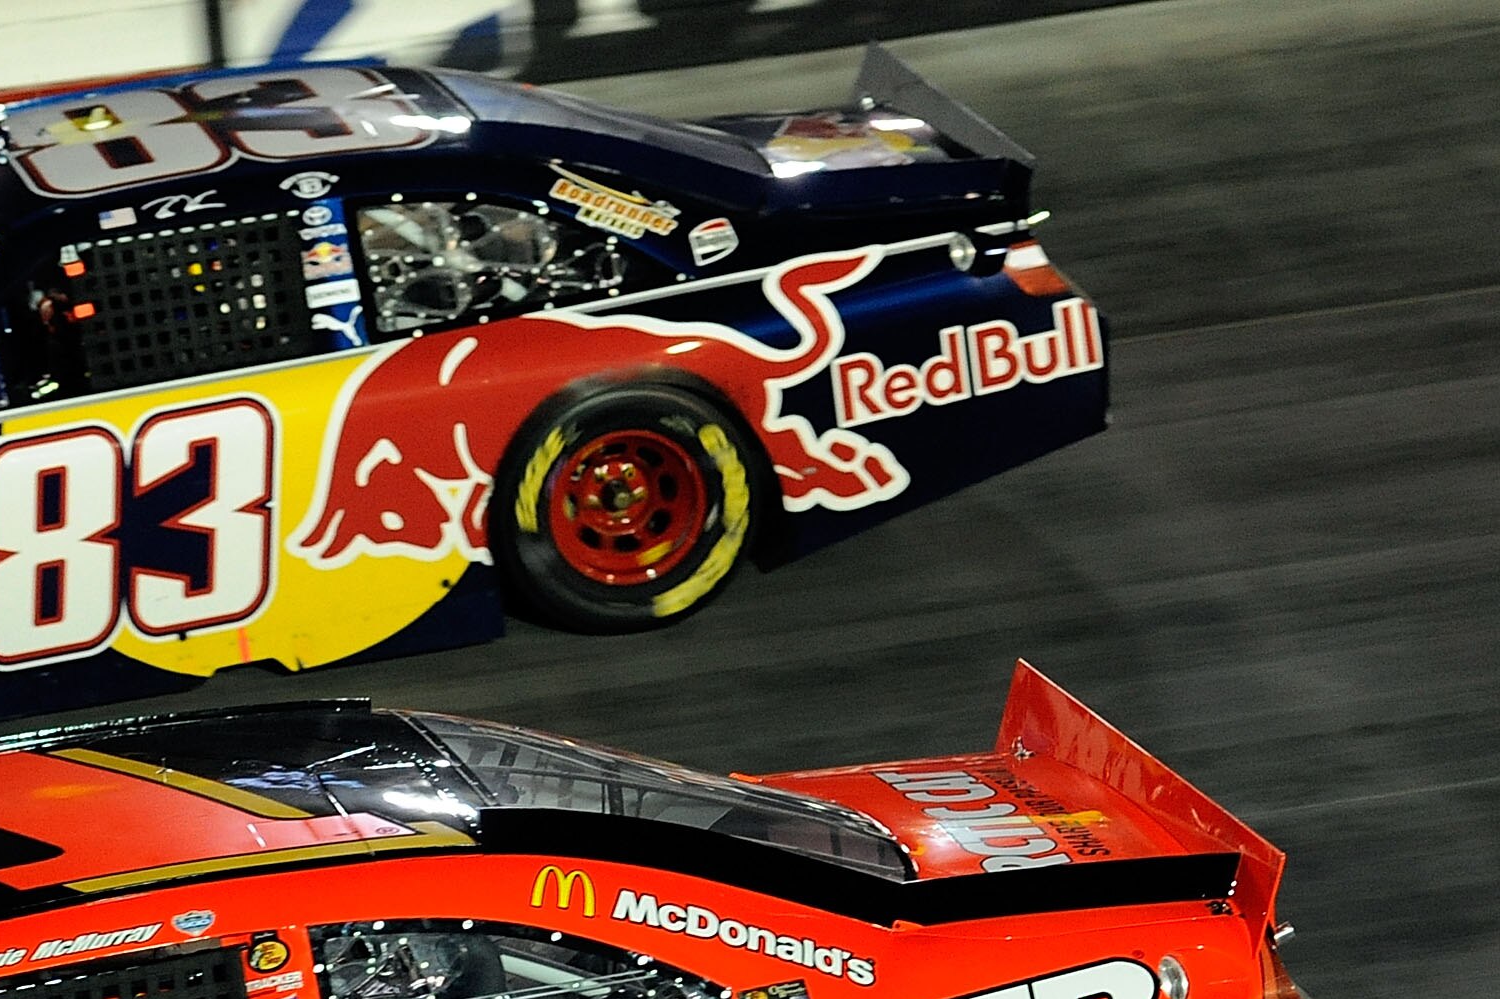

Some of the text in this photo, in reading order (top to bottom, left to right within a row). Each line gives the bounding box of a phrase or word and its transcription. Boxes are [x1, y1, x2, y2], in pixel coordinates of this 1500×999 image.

[7, 66, 438, 197] 83
[554, 180, 676, 233] Roadrunner
[835, 299, 1100, 424] Red Bull
[30, 922, 163, 962] McMurray
[611, 889, 874, 986] McDonald's
